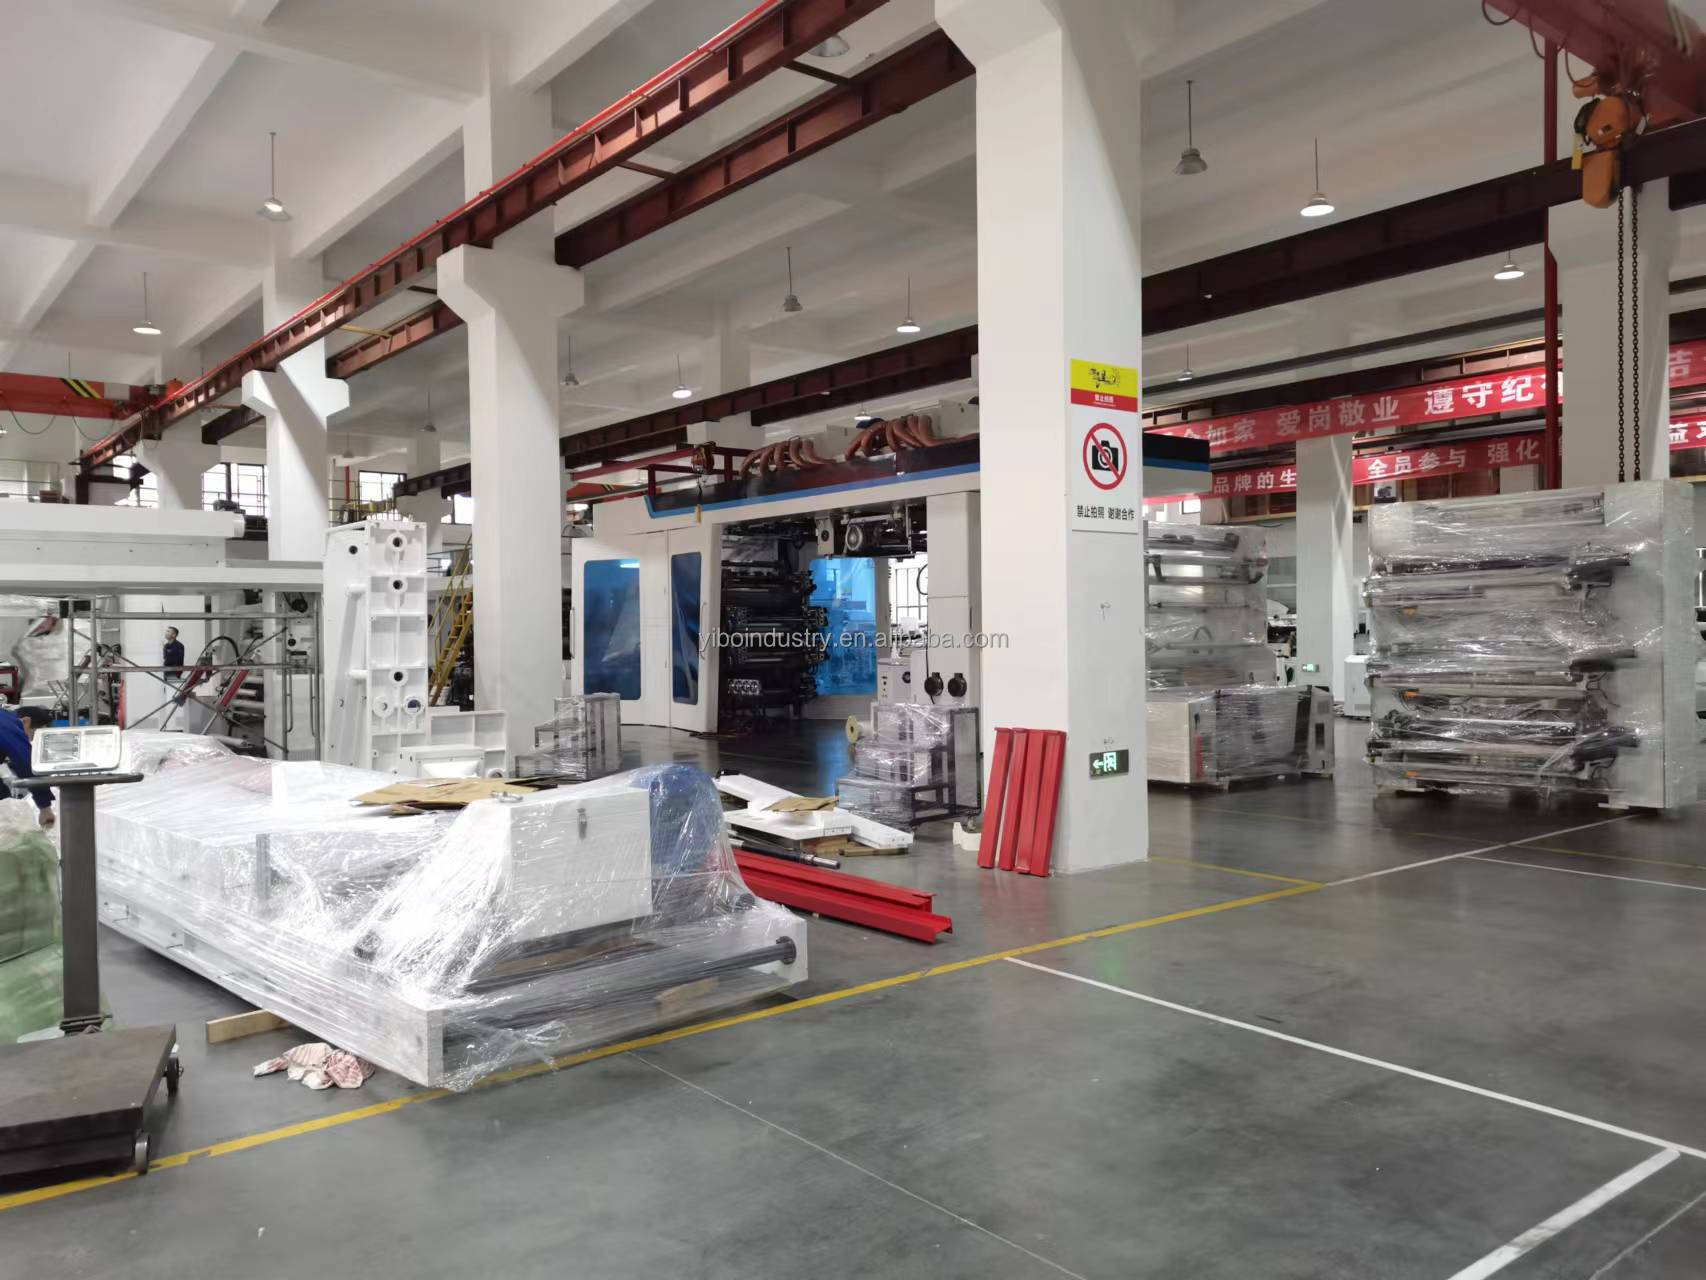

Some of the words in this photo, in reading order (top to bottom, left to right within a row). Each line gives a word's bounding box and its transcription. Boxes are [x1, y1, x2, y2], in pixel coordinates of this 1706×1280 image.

[1276, 396, 1400, 437] 爱岗敬业
[1367, 449, 1466, 480] 全员参与
[1077, 504, 1105, 519] 禁止拍照
[1108, 506, 1135, 521] 谢谢合作
